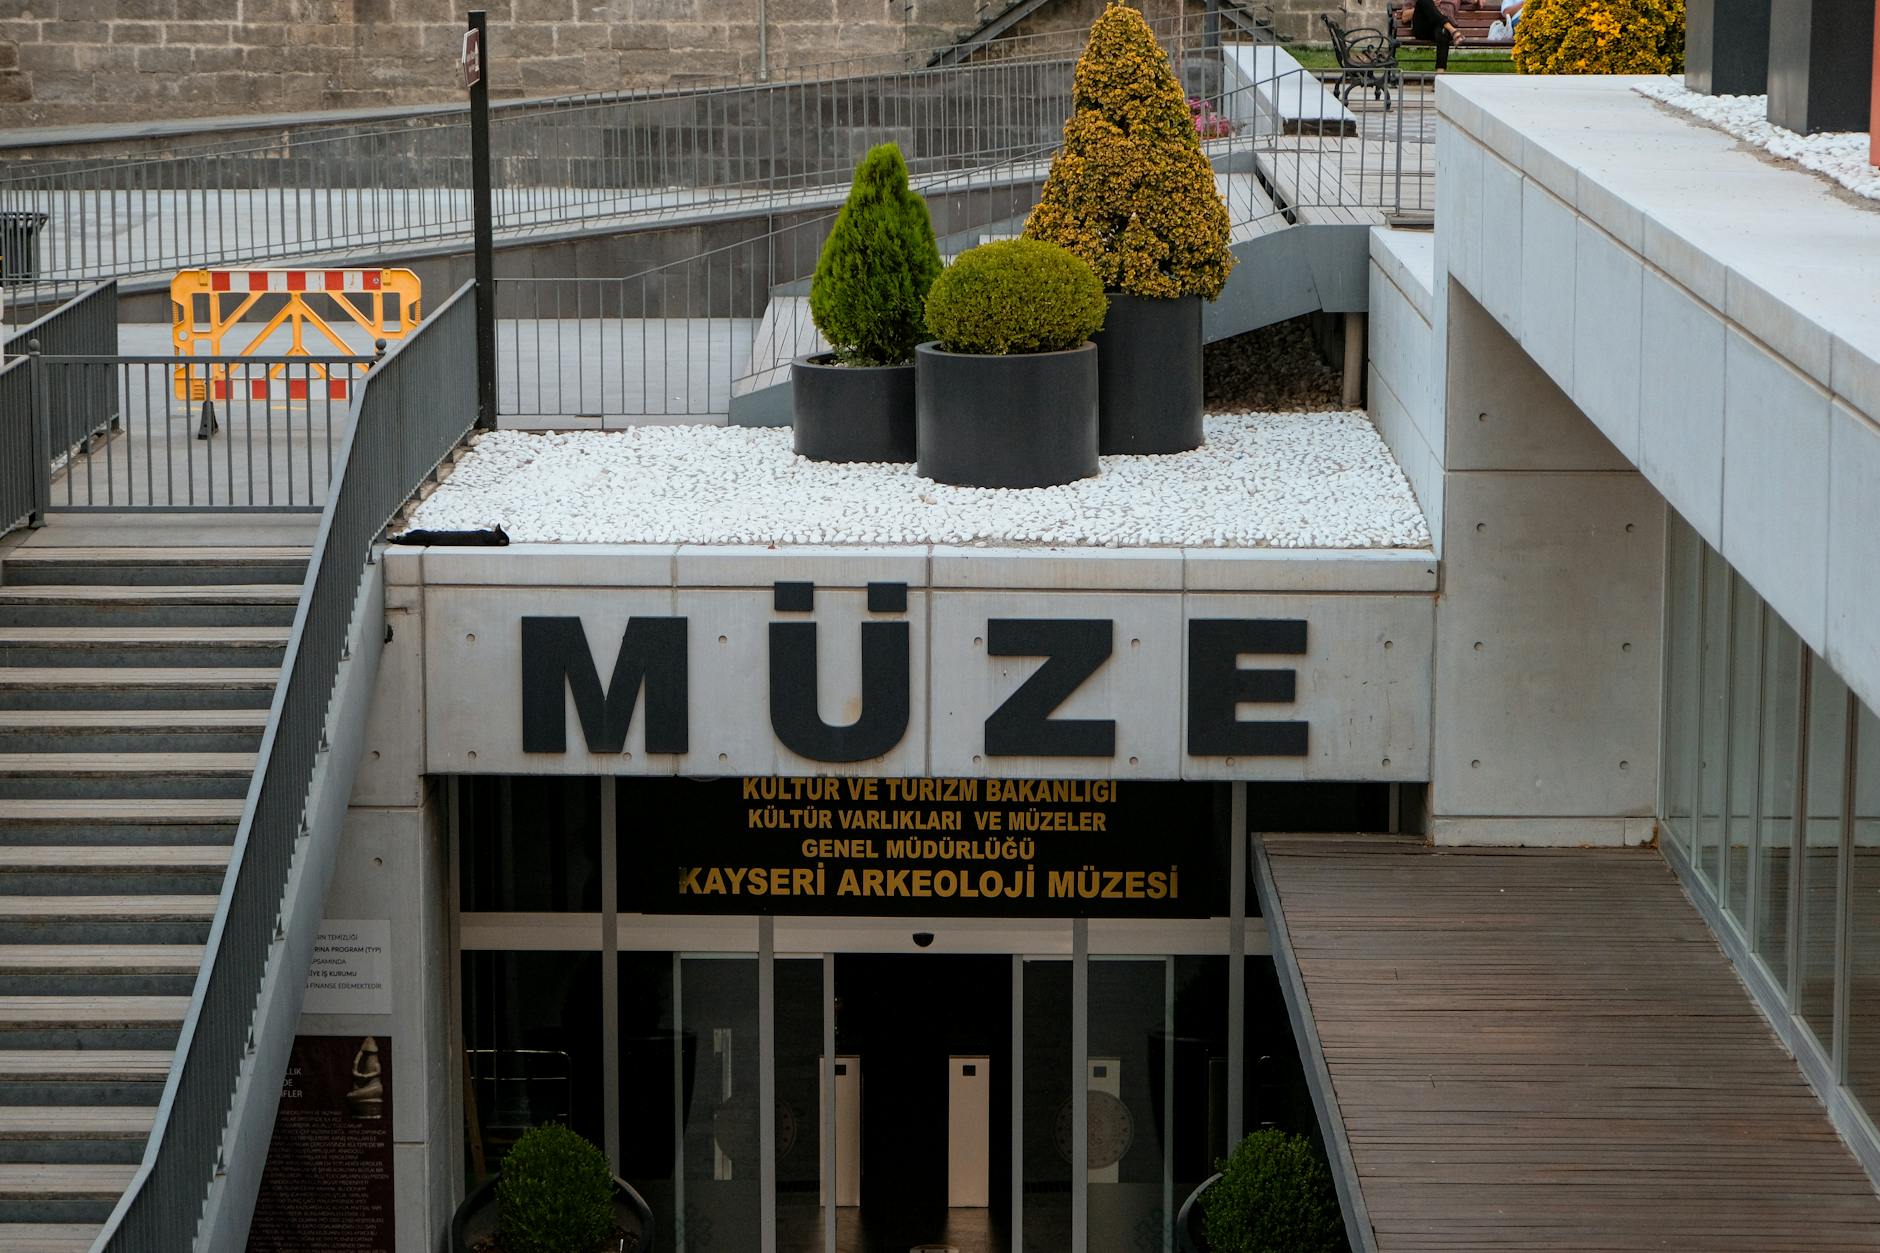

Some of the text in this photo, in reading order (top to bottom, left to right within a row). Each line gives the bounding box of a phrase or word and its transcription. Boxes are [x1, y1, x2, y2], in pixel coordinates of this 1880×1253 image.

[521, 582, 1309, 763] MÜZE
[847, 777, 879, 801] VE
[748, 807, 1106, 832] KÜLTÜR VARLIKLARI VE MÜZELER
[801, 837, 1035, 860] GENEL MÜDÜRLÜĞÜ
[679, 862, 1178, 899] KAYSERİ ARKEOLOJİ MÜZESİ
